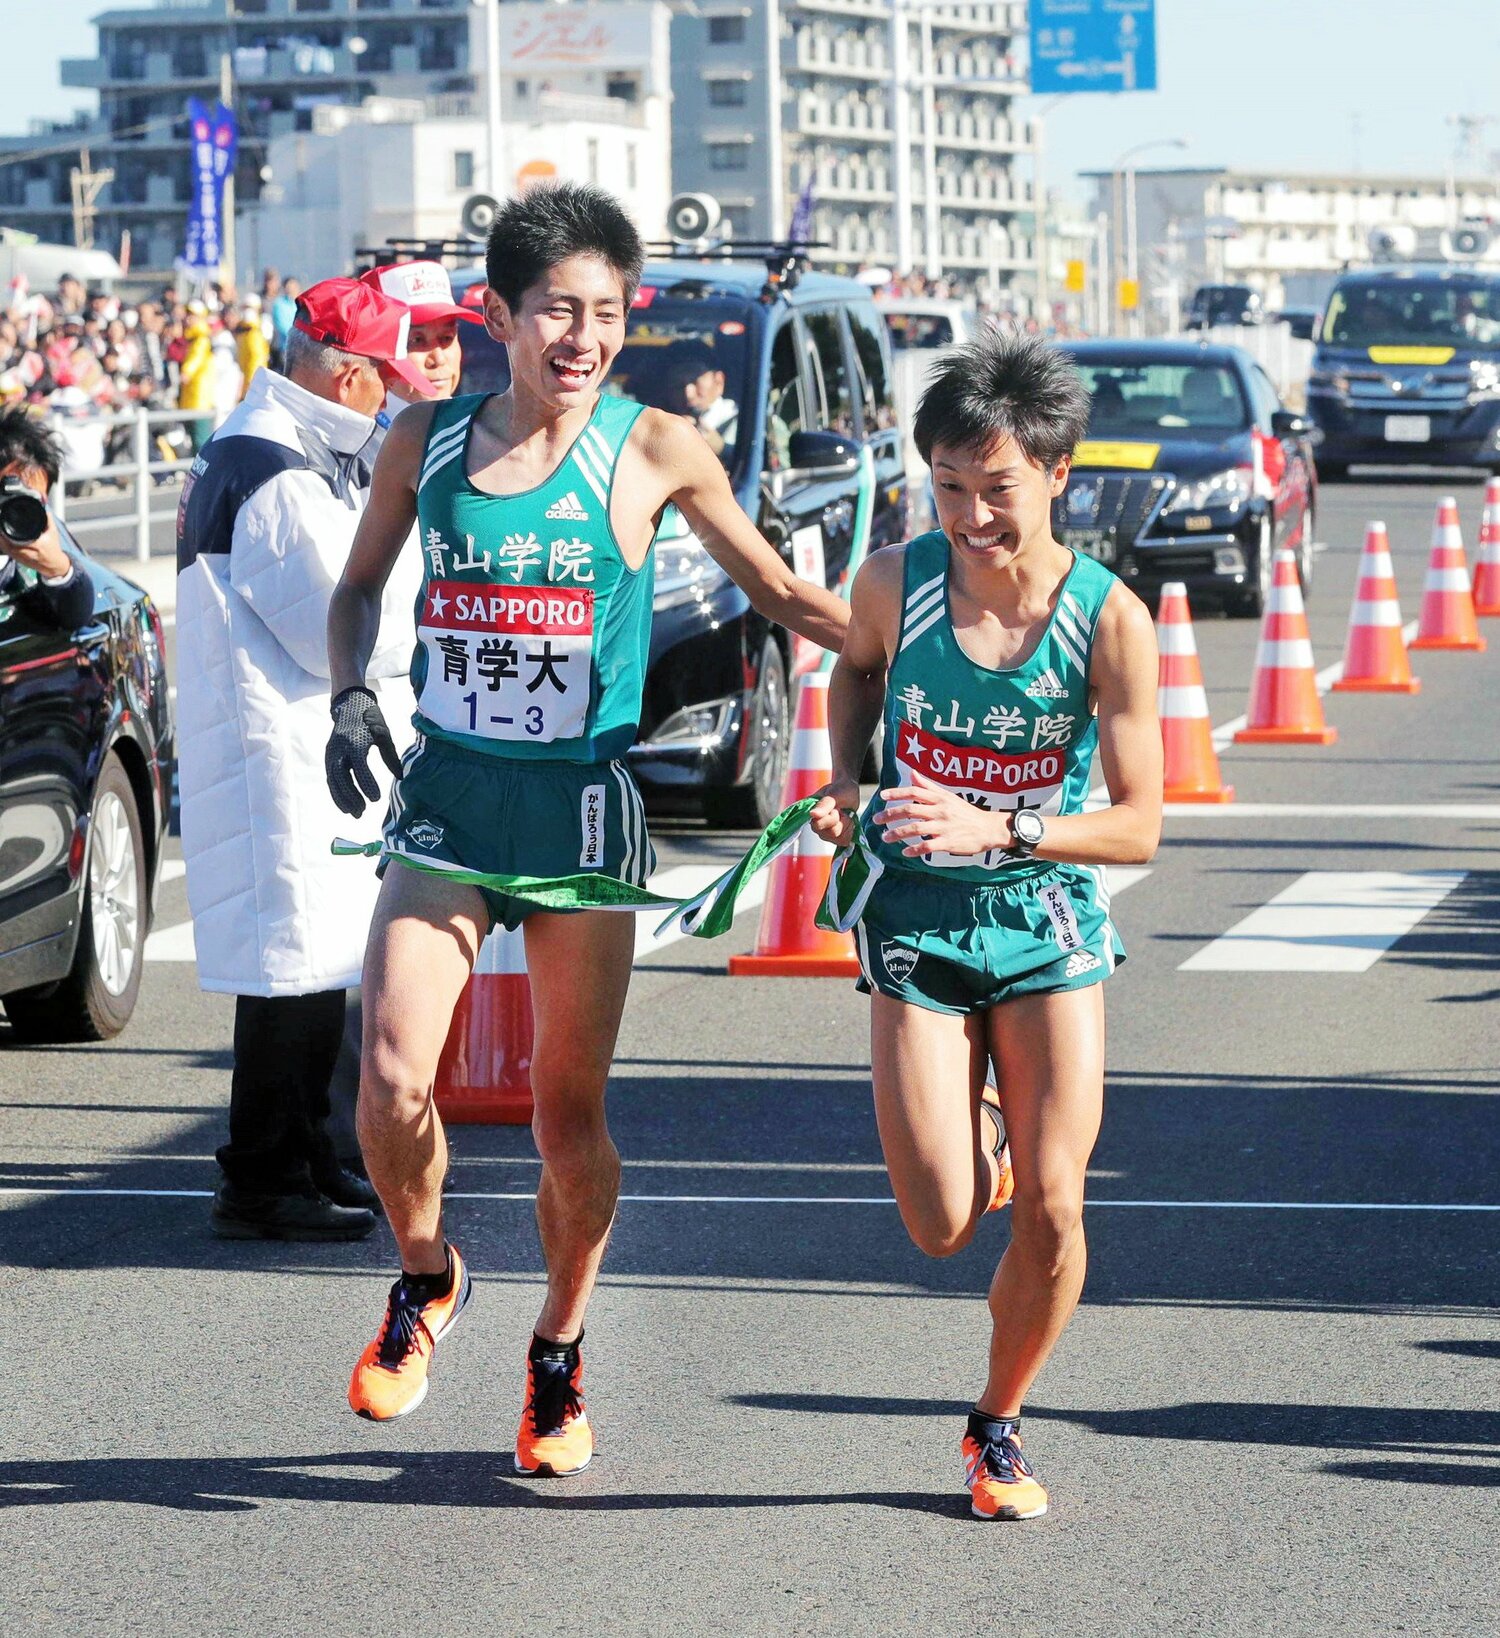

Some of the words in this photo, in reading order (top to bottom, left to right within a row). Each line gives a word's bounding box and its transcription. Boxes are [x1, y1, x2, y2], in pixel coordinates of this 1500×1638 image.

[545, 508, 589, 521] adidas
[424, 527, 595, 582] 青山学院
[455, 594, 585, 626] SAPPORO
[435, 635, 569, 694] 青学大
[463, 691, 544, 735] 1-3
[896, 683, 1076, 749] 青山学院
[1025, 685, 1069, 699] adidas
[930, 748, 1058, 787] SAPPORO
[586, 793, 599, 864] がんばろう日本
[1046, 889, 1077, 949] がんばろう日本
